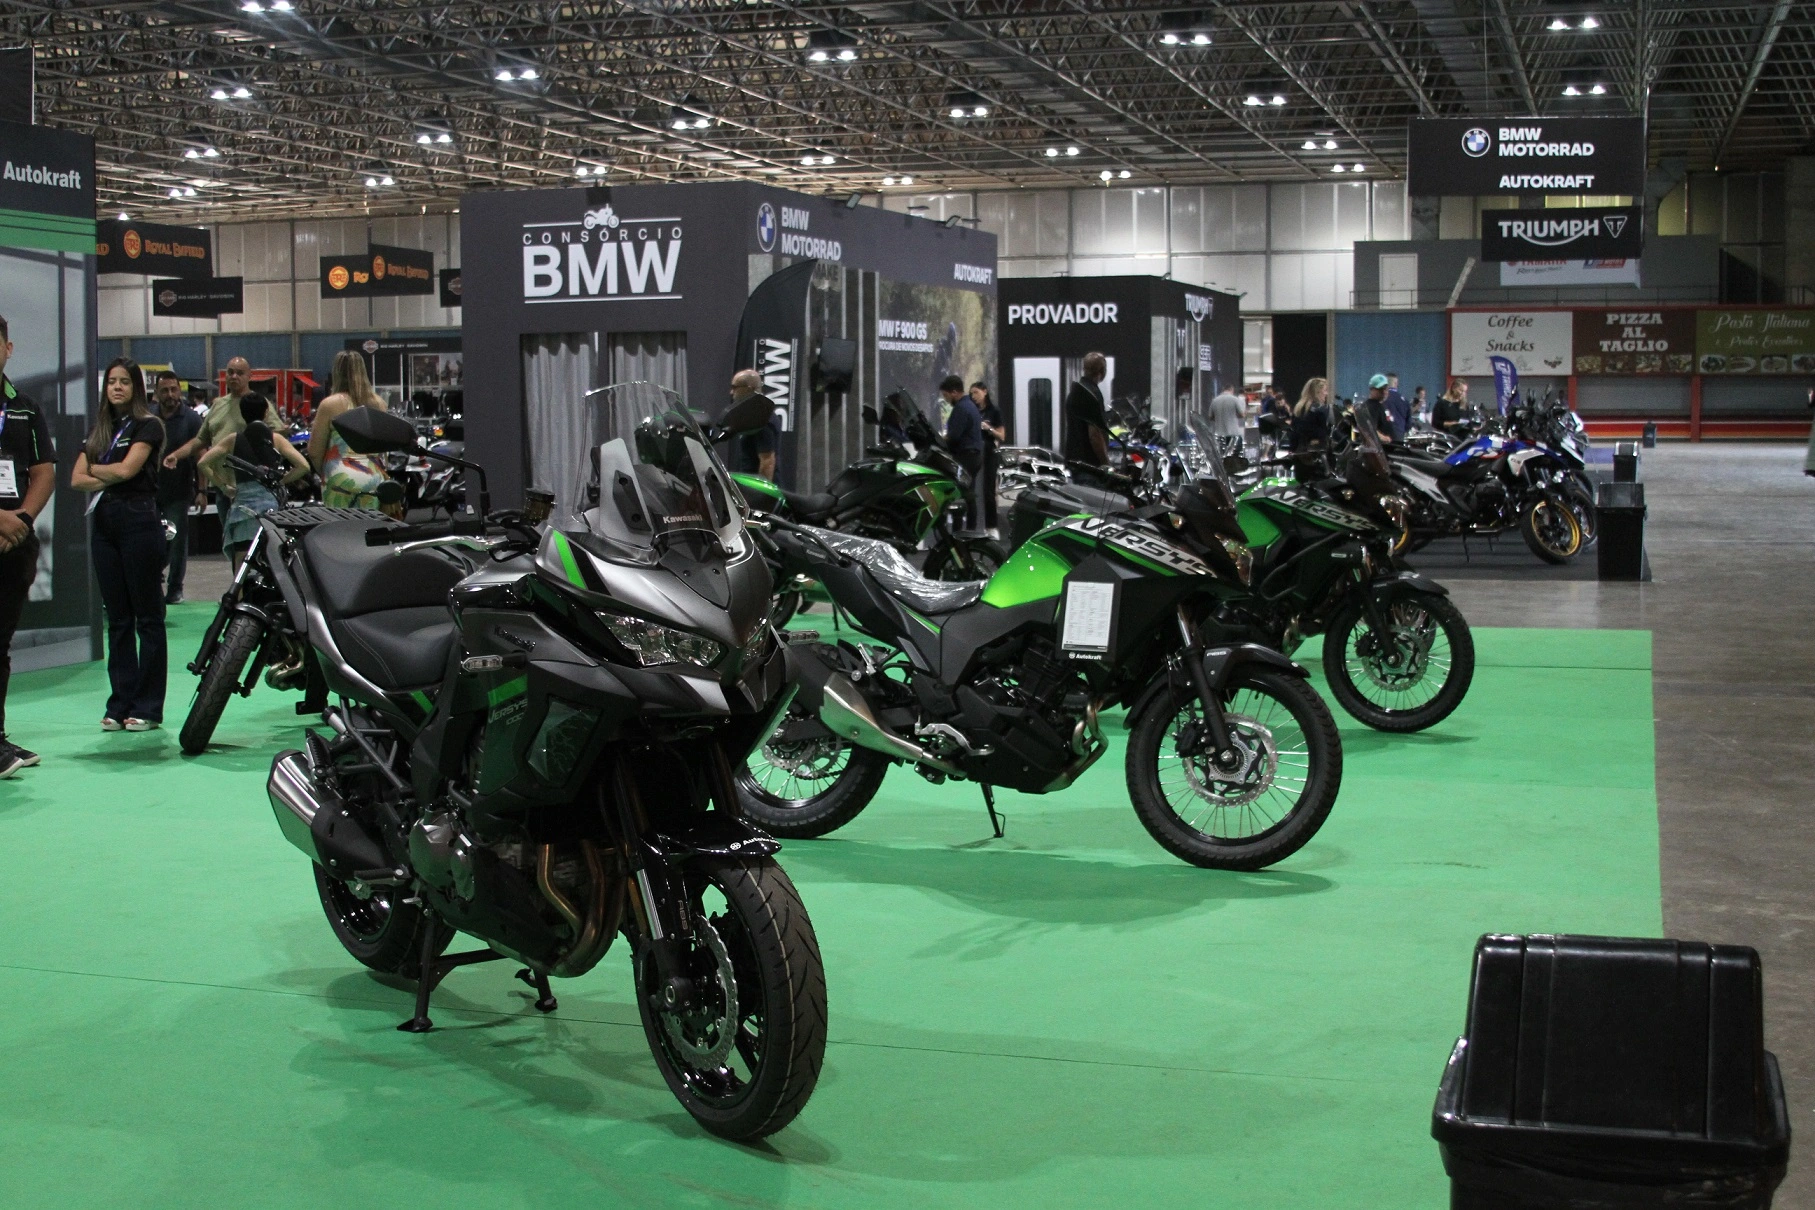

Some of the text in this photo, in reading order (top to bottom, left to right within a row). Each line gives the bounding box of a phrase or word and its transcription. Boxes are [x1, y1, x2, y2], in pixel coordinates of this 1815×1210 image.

[1499, 128, 1542, 141] BMW
[1499, 143, 1595, 157] MOTORRAD
[3, 161, 81, 190] Autokraft
[1499, 175, 1595, 188] AUTOKRAFT
[781, 206, 810, 231] BMW
[522, 227, 682, 245] CONSÓRCIO
[1498, 219, 1599, 243] TRIUMPH
[781, 233, 842, 261] MOTORRAD
[522, 240, 682, 298] BMW
[954, 263, 992, 285] AUTOKRAFT
[1008, 303, 1118, 325] PROVADOR
[1487, 315, 1533, 328] Coffee
[1606, 313, 1663, 325] PIZZA
[879, 319, 895, 338] MW
[901, 321, 916, 339] 900
[916, 322, 928, 340] GS
[1505, 331, 1514, 340] &
[1622, 327, 1646, 338] AL
[1485, 340, 1535, 352] Snacks
[1600, 340, 1668, 352] TAGLIO
[662, 514, 703, 524] Kawasaki
[1080, 517, 1218, 579] VERSYS
